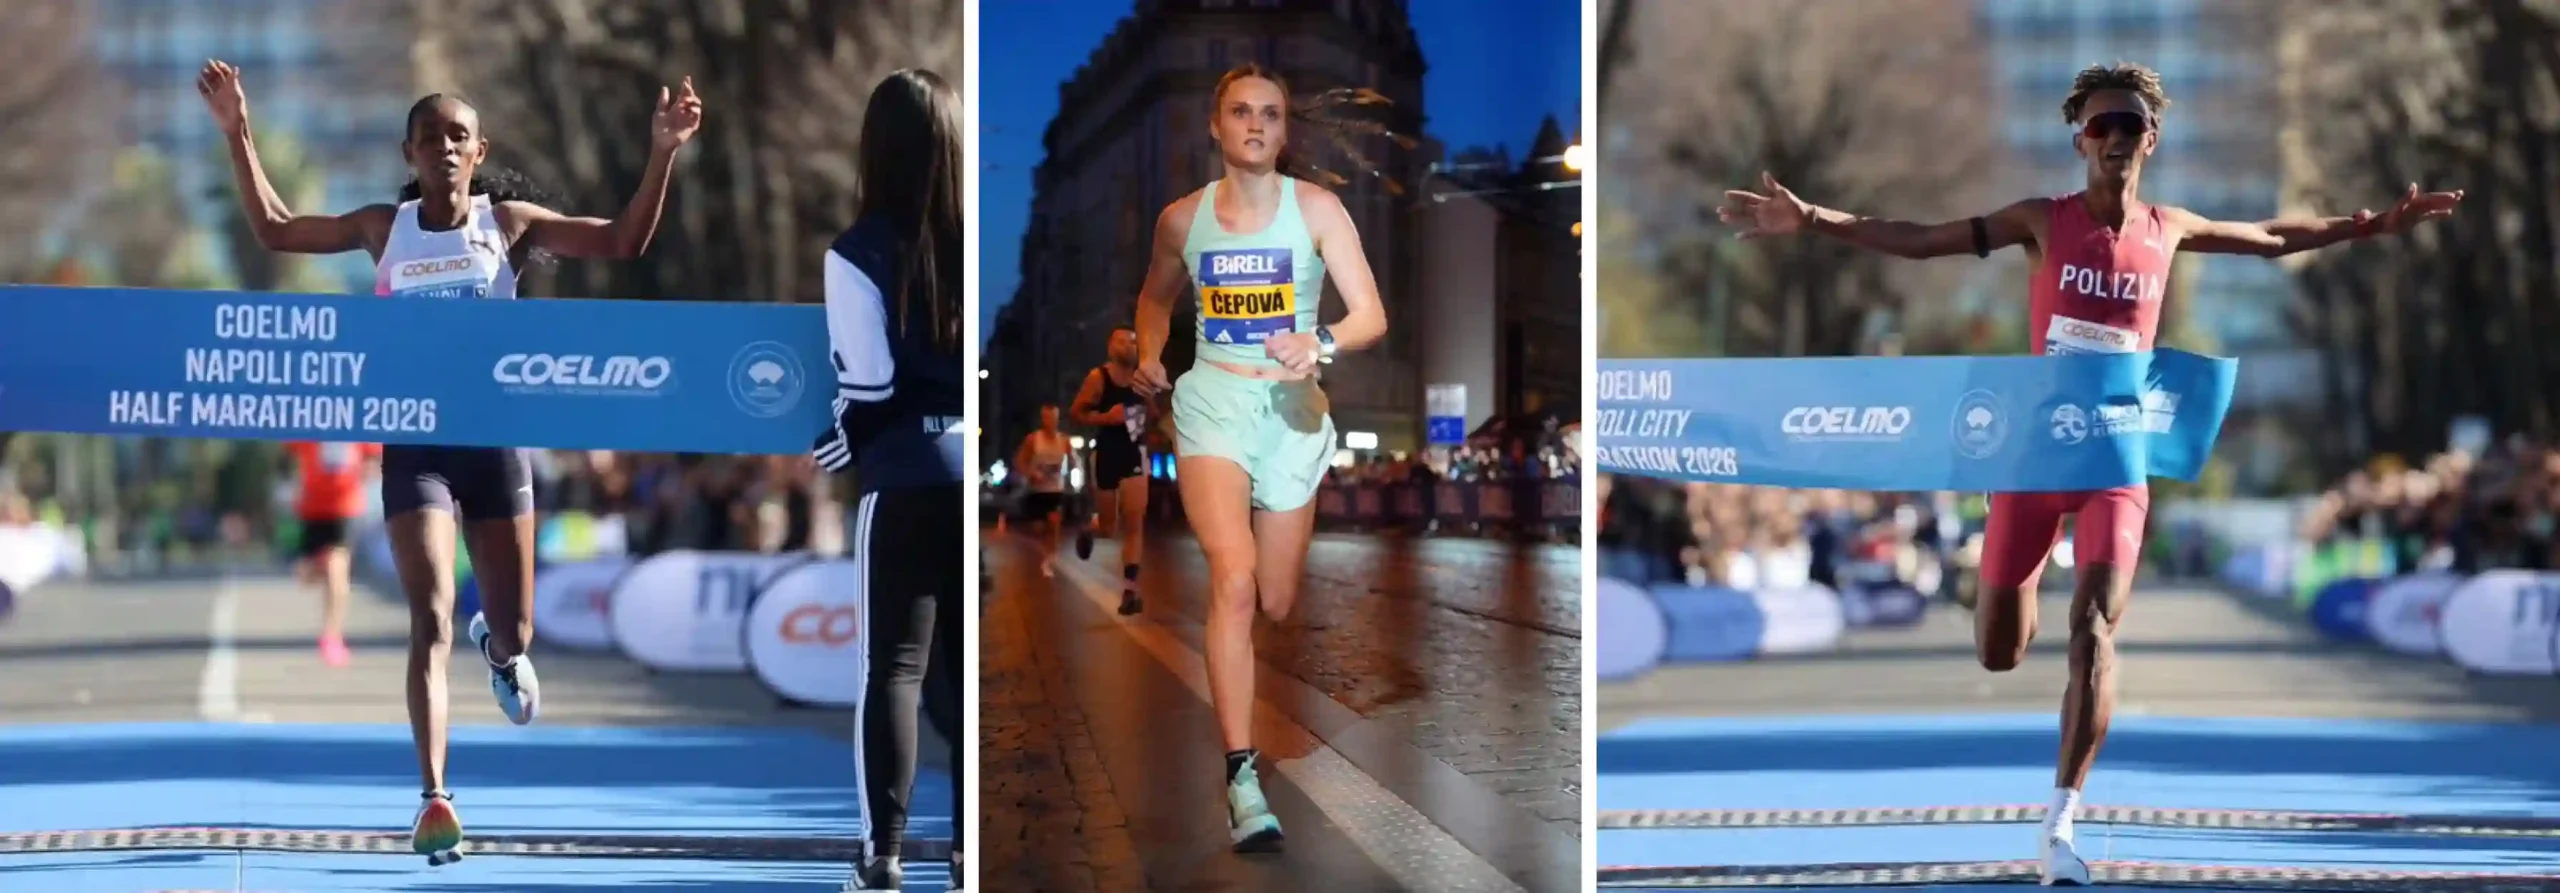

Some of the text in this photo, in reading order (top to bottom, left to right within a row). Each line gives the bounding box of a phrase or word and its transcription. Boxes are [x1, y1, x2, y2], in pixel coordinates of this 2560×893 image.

[402, 257, 472, 277] COELMO
[2059, 263, 2163, 300] POLIZIA
[1211, 288, 1286, 315] ČEPOVÁ
[215, 303, 337, 341] COELMO
[185, 348, 366, 387] NAPOLI CITY
[493, 353, 671, 388] COELMO
[1596, 370, 1672, 401] OELMO
[109, 390, 436, 433] HALF MARATHON 2026
[1638, 408, 1692, 438] CITY
[1781, 406, 1911, 434] COELMO
[1682, 447, 1738, 476] 2026
